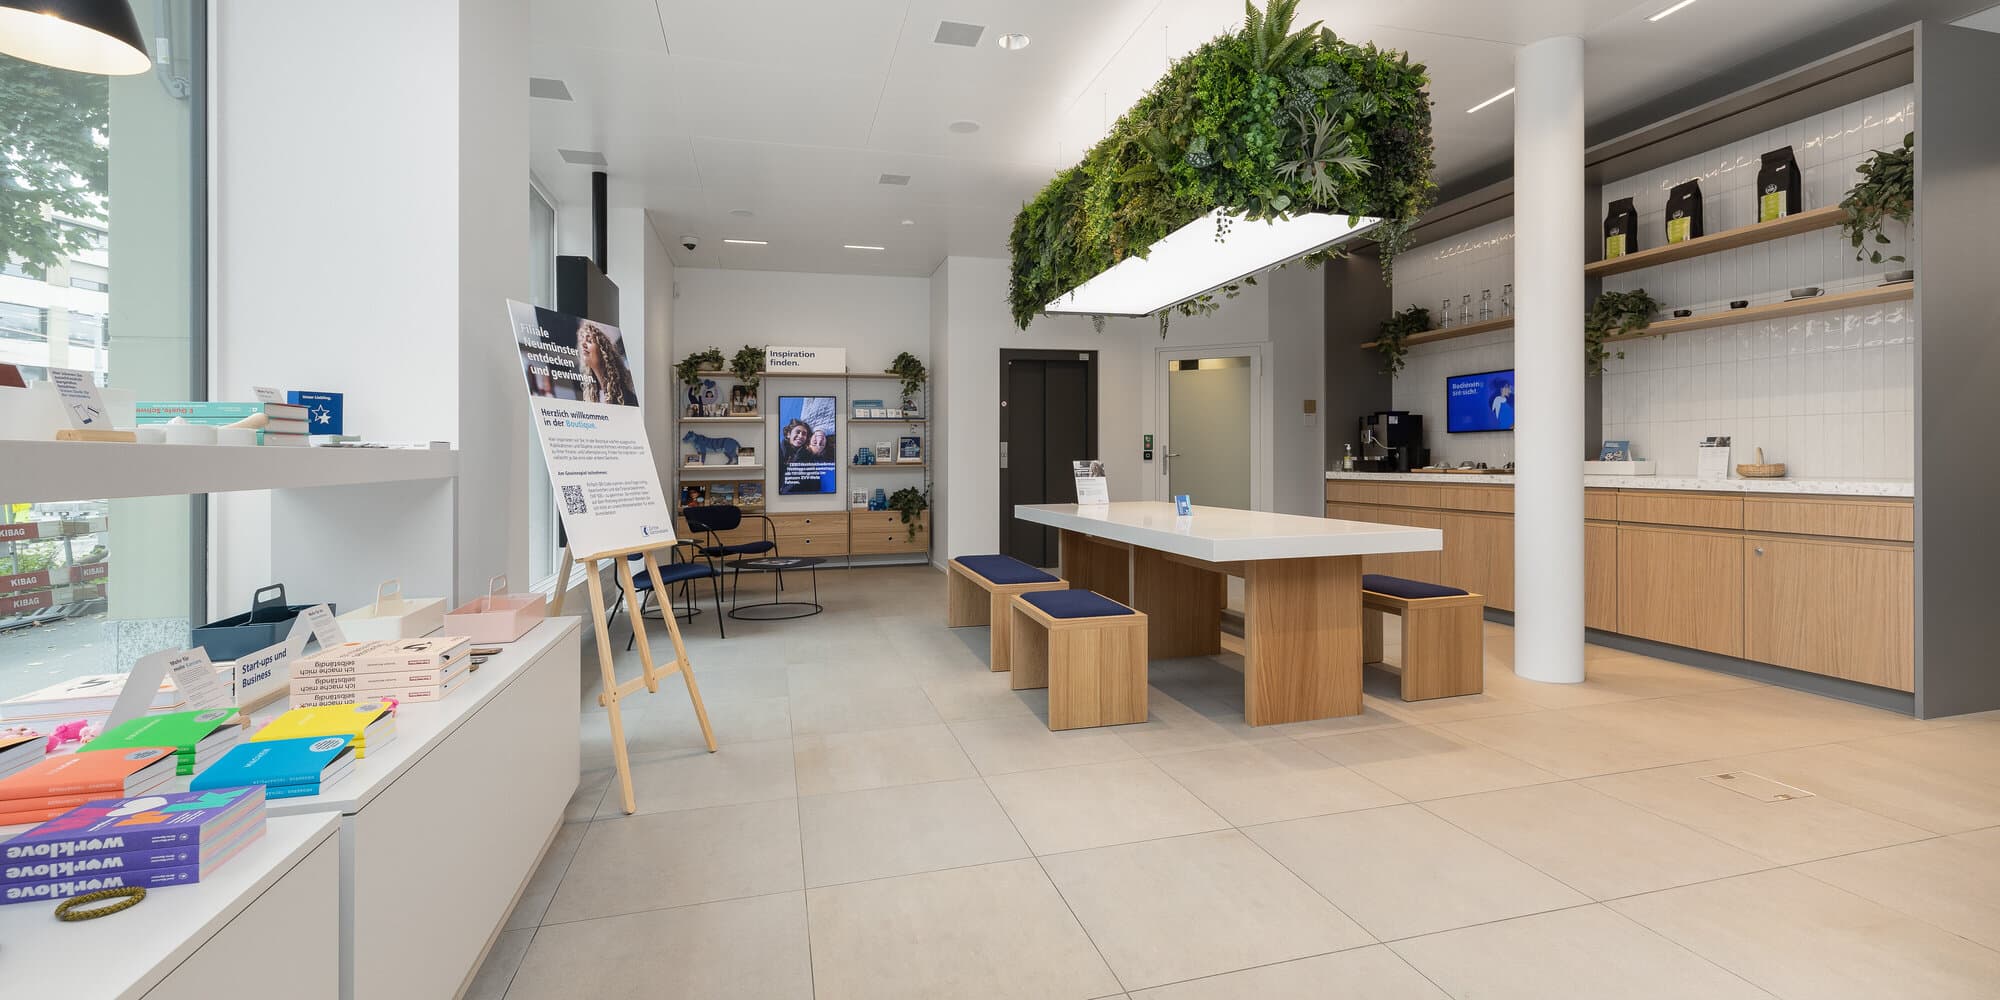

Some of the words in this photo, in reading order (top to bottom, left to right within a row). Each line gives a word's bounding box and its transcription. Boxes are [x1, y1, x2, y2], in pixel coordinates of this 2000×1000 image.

[520, 323, 550, 338] Filiale
[524, 337, 579, 356] Neumünster
[528, 352, 575, 368] entdecken
[770, 350, 815, 358] Inspiration
[530, 365, 550, 376] und
[551, 369, 597, 383] gewinnen.
[541, 408, 569, 418] Herzlich
[570, 411, 608, 421] willkommen
[554, 418, 564, 427] der
[0, 528, 25, 537] KIBAG
[83, 566, 104, 576] KIBAG
[11, 576, 37, 587] KIBAG
[13, 597, 40, 608] KIBAG
[242, 655, 273, 675] Start-ups
[274, 648, 287, 661] und
[242, 670, 272, 688] Business
[315, 693, 355, 701] selbständig
